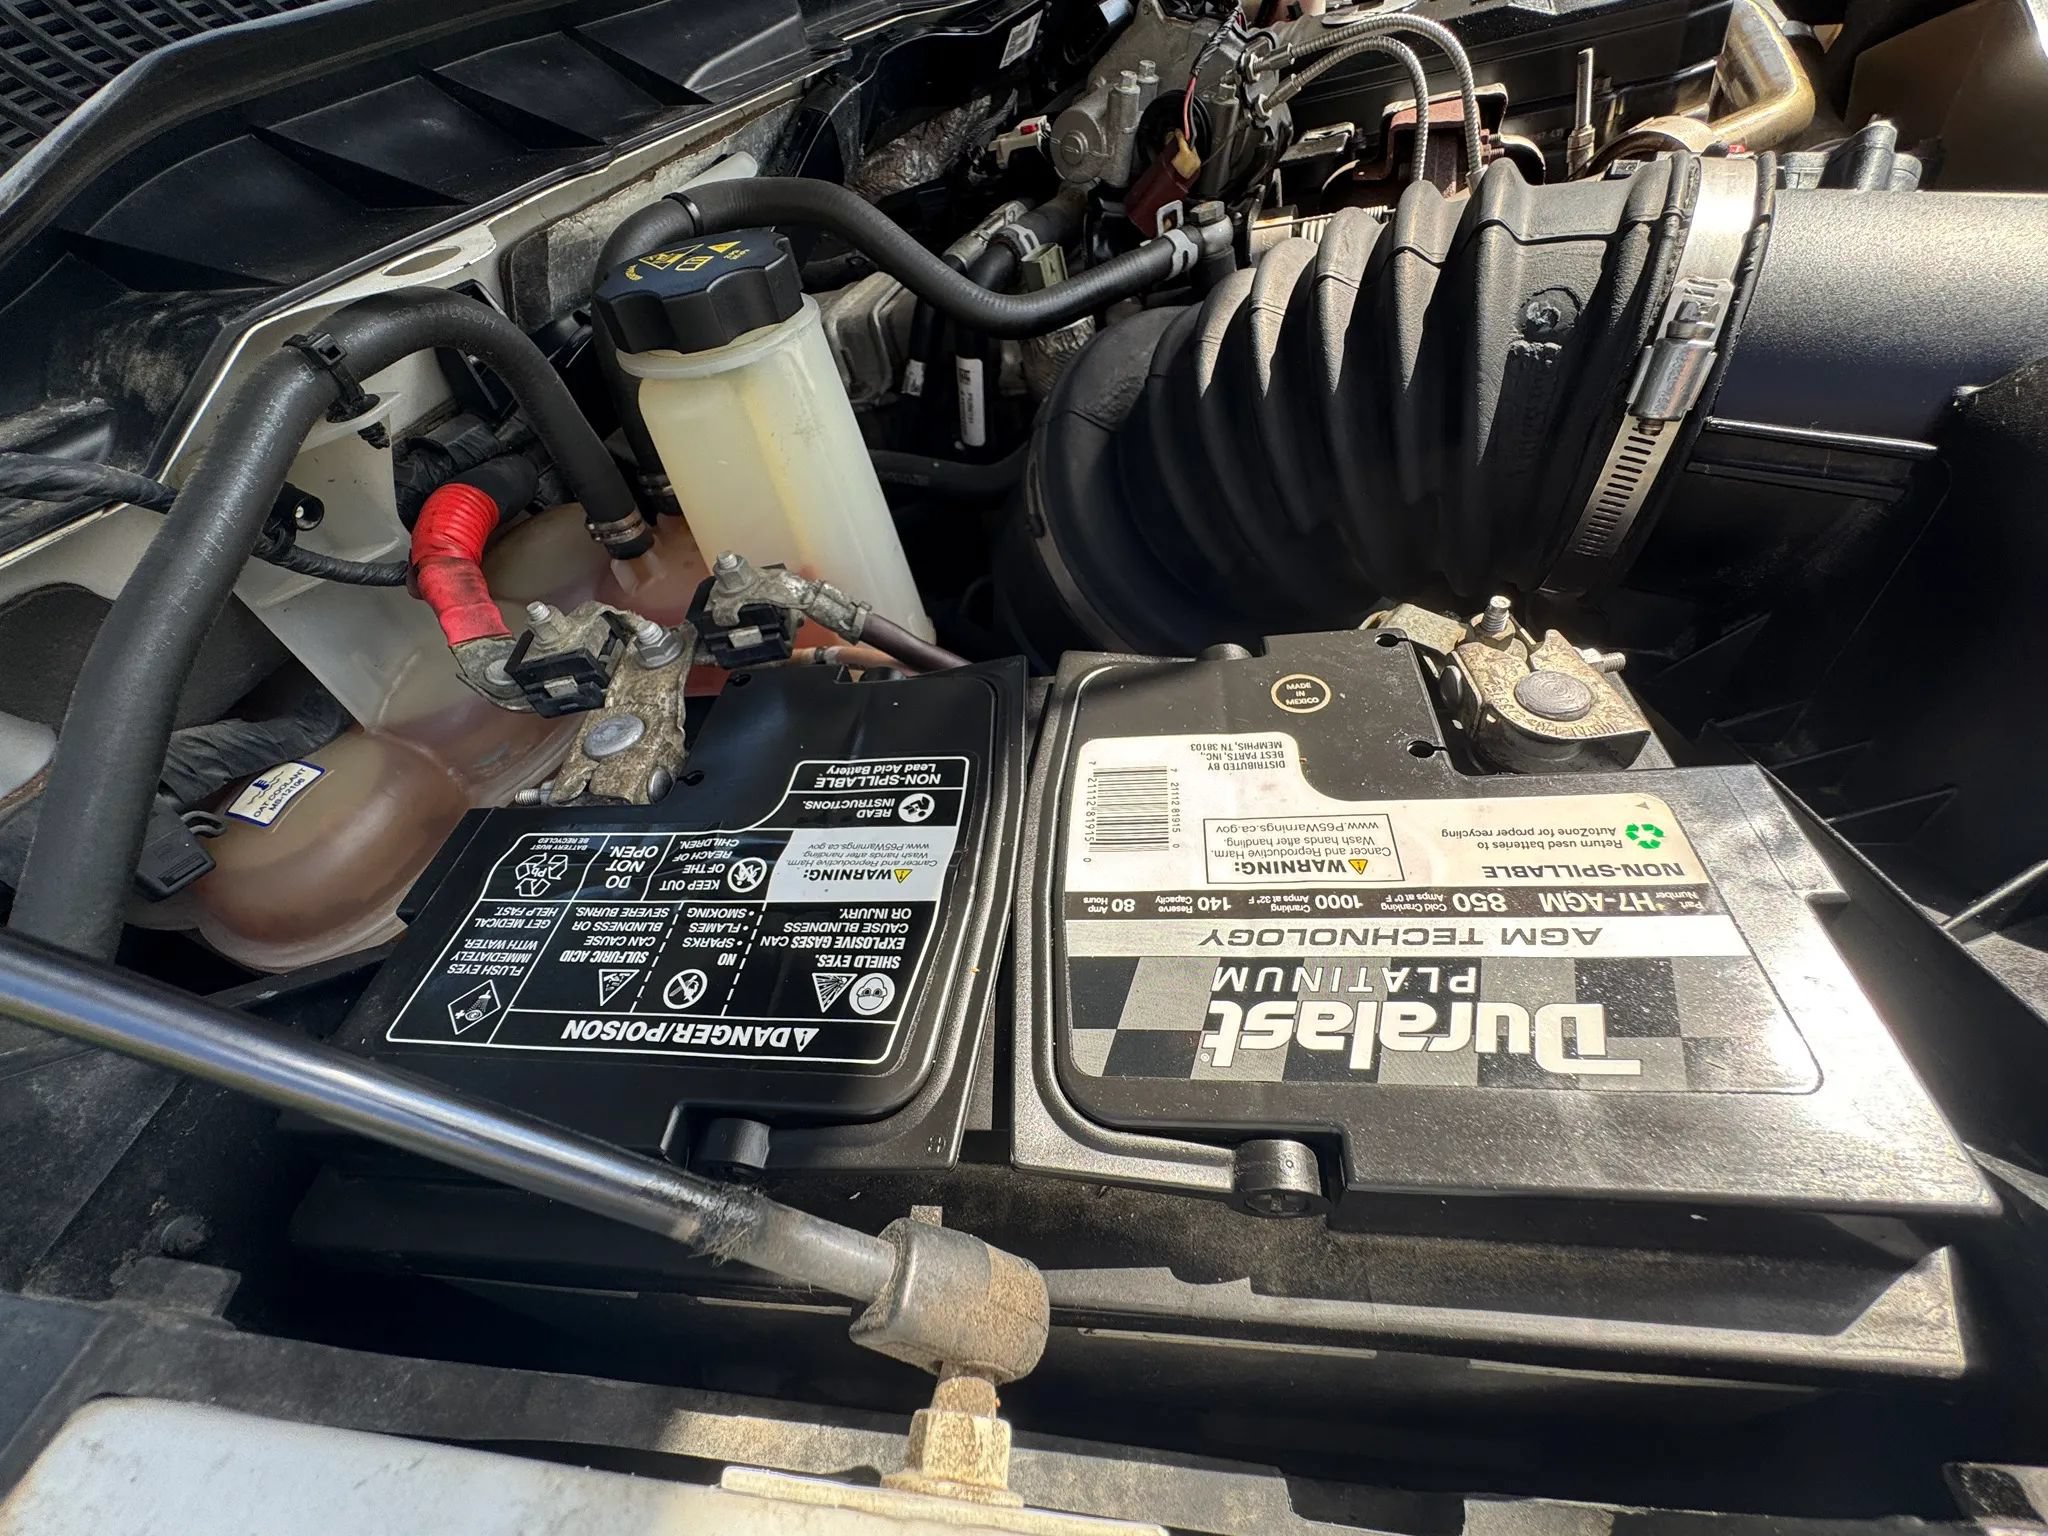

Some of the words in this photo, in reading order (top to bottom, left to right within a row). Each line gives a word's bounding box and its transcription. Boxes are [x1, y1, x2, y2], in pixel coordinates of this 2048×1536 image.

[1286, 682, 1312, 690] MADE
[1286, 697, 1320, 705] MEXICO
[1190, 743, 1219, 752] 38103
[1234, 741, 1282, 750] MEMPHIS,
[1223, 751, 1257, 760] PARTS,
[1258, 750, 1284, 760] BEST
[826, 764, 870, 776] Battery
[871, 764, 902, 774] Acid
[904, 763, 936, 773] Lead
[1207, 762, 1220, 771] BY
[1222, 760, 1286, 770] DISTRIBUTED
[814, 774, 941, 788] NON-SPILLABLE
[253, 802, 269, 818] OAT
[269, 768, 306, 801] COOLANT
[1086, 778, 1098, 806] 21112
[1170, 782, 1179, 806] 21112
[802, 798, 895, 809] INSTRUCTIONS.
[856, 808, 892, 818] READ
[1171, 808, 1180, 832] 81915
[1084, 811, 1096, 842] 81915
[1216, 820, 1379, 835] www.P65Warnings.ca.gov
[1496, 826, 1536, 838] proper
[1557, 826, 1616, 838] AutoZone
[1441, 828, 1493, 840] recycling
[1540, 828, 1555, 838] for
[679, 838, 740, 848] CHILDREN.
[1223, 836, 1274, 849] handling.
[1275, 838, 1302, 848] after
[1304, 836, 1338, 848] hands
[1340, 836, 1375, 847] Wash
[1476, 840, 1489, 850] to
[1491, 840, 1544, 850] batteries
[1546, 840, 1577, 850] used
[1580, 839, 1622, 850] Return
[609, 846, 659, 858] OPEN.
[672, 852, 690, 862] OF
[692, 850, 733, 860] REACH
[1210, 849, 1245, 860] Harm.
[1248, 845, 1322, 860] Reproductive
[1324, 847, 1346, 858] and
[1348, 846, 1391, 857] Cancer
[604, 859, 645, 872] NOT
[706, 863, 725, 873] OF
[786, 858, 814, 867] Harm.
[816, 858, 879, 867] Reproductive
[902, 859, 938, 868] Cancer
[1234, 859, 1346, 874] WARNING:
[530, 867, 548, 877] Pb
[682, 863, 707, 874] THE
[1481, 862, 1686, 878] NON-SPILLABLE
[802, 868, 892, 881] WARNING:
[606, 875, 632, 888] DO
[658, 880, 686, 890] OUT
[686, 880, 721, 890] KEEP
[1154, 894, 1193, 905] Capacity
[1248, 896, 1255, 904] F
[1272, 896, 1282, 904] at
[1282, 894, 1309, 904] Amps
[1384, 894, 1392, 902] F
[1405, 894, 1415, 902] at
[1416, 892, 1444, 902] Amps
[1656, 890, 1698, 899] Number
[1082, 896, 1108, 906] Hours
[1111, 898, 1136, 912] 80
[1198, 896, 1232, 911] 140
[1314, 894, 1364, 909] 1000
[1380, 900, 1422, 912] Cranking
[1452, 892, 1506, 912] 850
[1538, 891, 1657, 912] H7-AGM
[1678, 900, 1704, 910] Part
[494, 906, 526, 916] FAST.
[525, 907, 559, 917] HELP
[574, 906, 620, 917] BURNS.
[620, 907, 670, 918] SEVERE
[687, 907, 748, 918] SMOKING
[1087, 904, 1108, 914] Amp
[1158, 906, 1193, 914] Reserve
[1270, 902, 1311, 913] Cranking
[1424, 902, 1447, 912] Cold
[839, 908, 889, 919] INJURY.
[891, 908, 912, 919] OR
[474, 918, 526, 928] MEDICAL
[524, 918, 551, 928] GET
[572, 921, 592, 931] OR
[594, 921, 664, 932] BLINDNESS
[688, 922, 742, 933] FLAMES
[783, 922, 860, 933] BLINDNESS
[863, 922, 909, 933] CAUSE
[584, 936, 629, 946] CAUSE
[630, 936, 656, 946] CAN
[760, 936, 790, 947] CAN
[791, 936, 832, 948] GASES
[834, 936, 906, 949] EXPLOSIVE
[1198, 928, 1484, 946] TECHNOLOGY
[1500, 928, 1603, 946] AGM
[464, 938, 508, 950] WATER.
[507, 939, 538, 950] WITH
[682, 938, 736, 948] SPARKS
[450, 950, 532, 962] IMMEDIATELY
[559, 950, 591, 962] ACID
[591, 950, 649, 963] SULFURIC
[717, 954, 737, 966] NO
[815, 954, 852, 967] EYES.
[855, 955, 901, 968] SHIELD
[447, 964, 480, 974] EYES
[479, 964, 524, 976] FLUSH
[1210, 966, 1477, 992] PLATINUM
[561, 1020, 792, 1047] DANGER/POISON
[1201, 1000, 1641, 1075] Duralast
